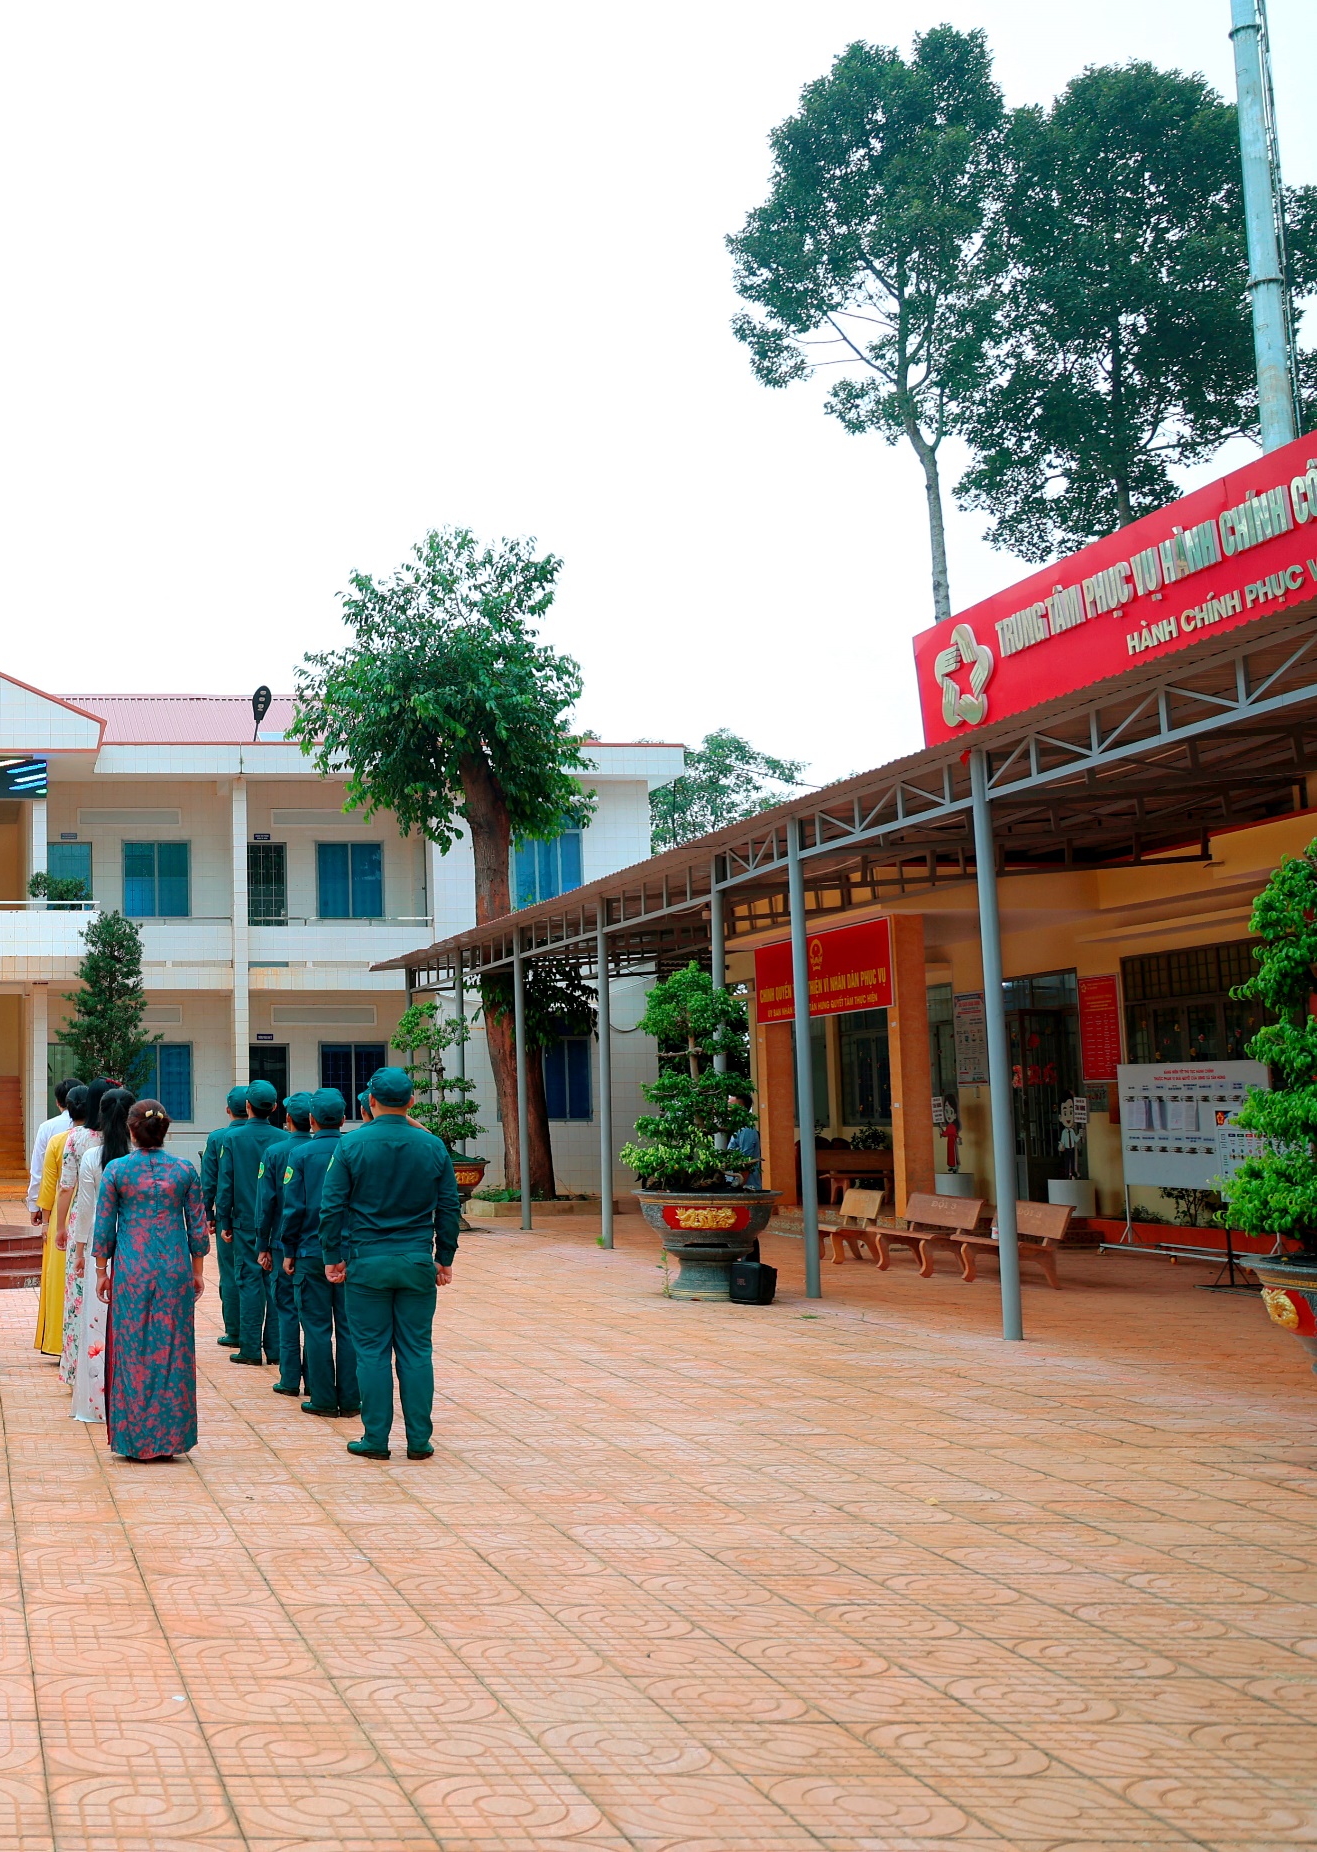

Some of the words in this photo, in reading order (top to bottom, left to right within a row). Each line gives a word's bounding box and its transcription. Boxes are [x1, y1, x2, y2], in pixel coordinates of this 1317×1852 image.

[995, 602, 1049, 657] TRUNG
[1044, 585, 1086, 635] TÂM
[1082, 562, 1134, 618] PHỤC
[1130, 546, 1162, 601] VỤ
[1159, 526, 1222, 584] HÀNH
[1219, 490, 1294, 556] CHÍNH
[1127, 620, 1178, 655] HÀNH
[1182, 591, 1243, 632] CHÍNH
[1245, 565, 1304, 608] PHỤC
[860, 968, 877, 988] PHỤC
[877, 967, 887, 986] VỤ
